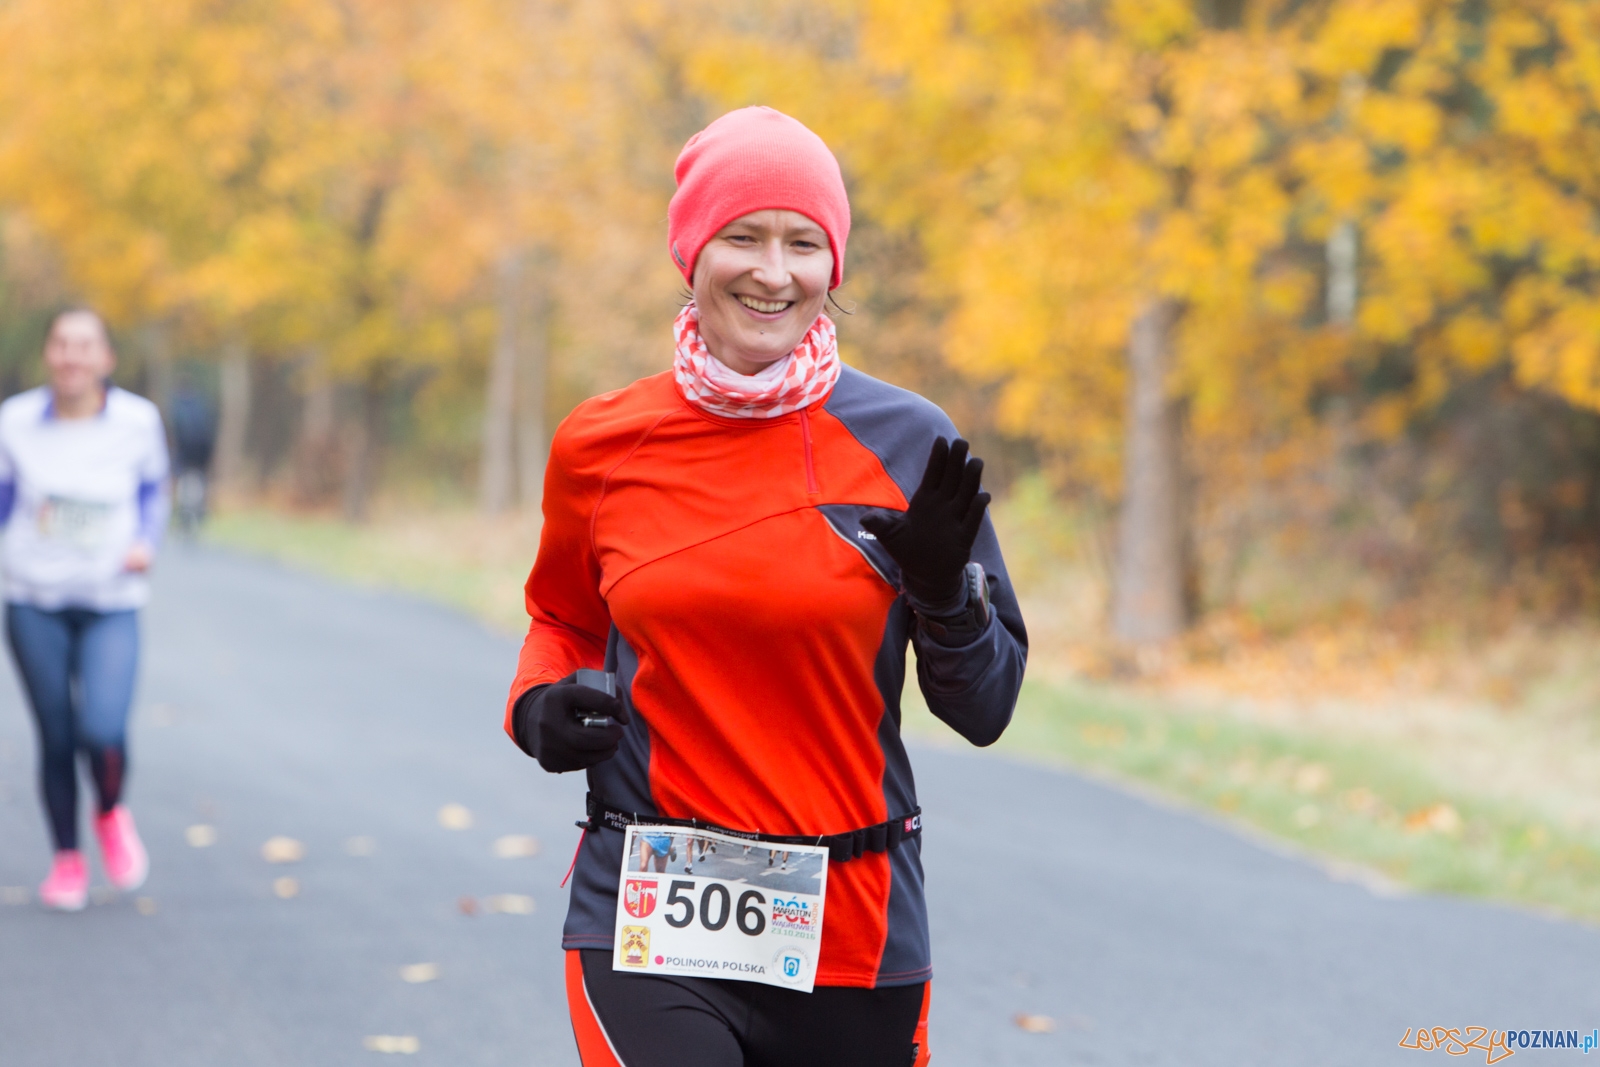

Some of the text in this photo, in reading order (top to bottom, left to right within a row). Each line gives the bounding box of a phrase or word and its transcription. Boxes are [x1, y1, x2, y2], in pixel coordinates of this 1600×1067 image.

[664, 879, 767, 937] 506
[773, 906, 812, 918] MARATON
[771, 927, 816, 940] 23.10.2016
[666, 956, 719, 969] POLINOVA
[722, 961, 766, 975] POLSKA
